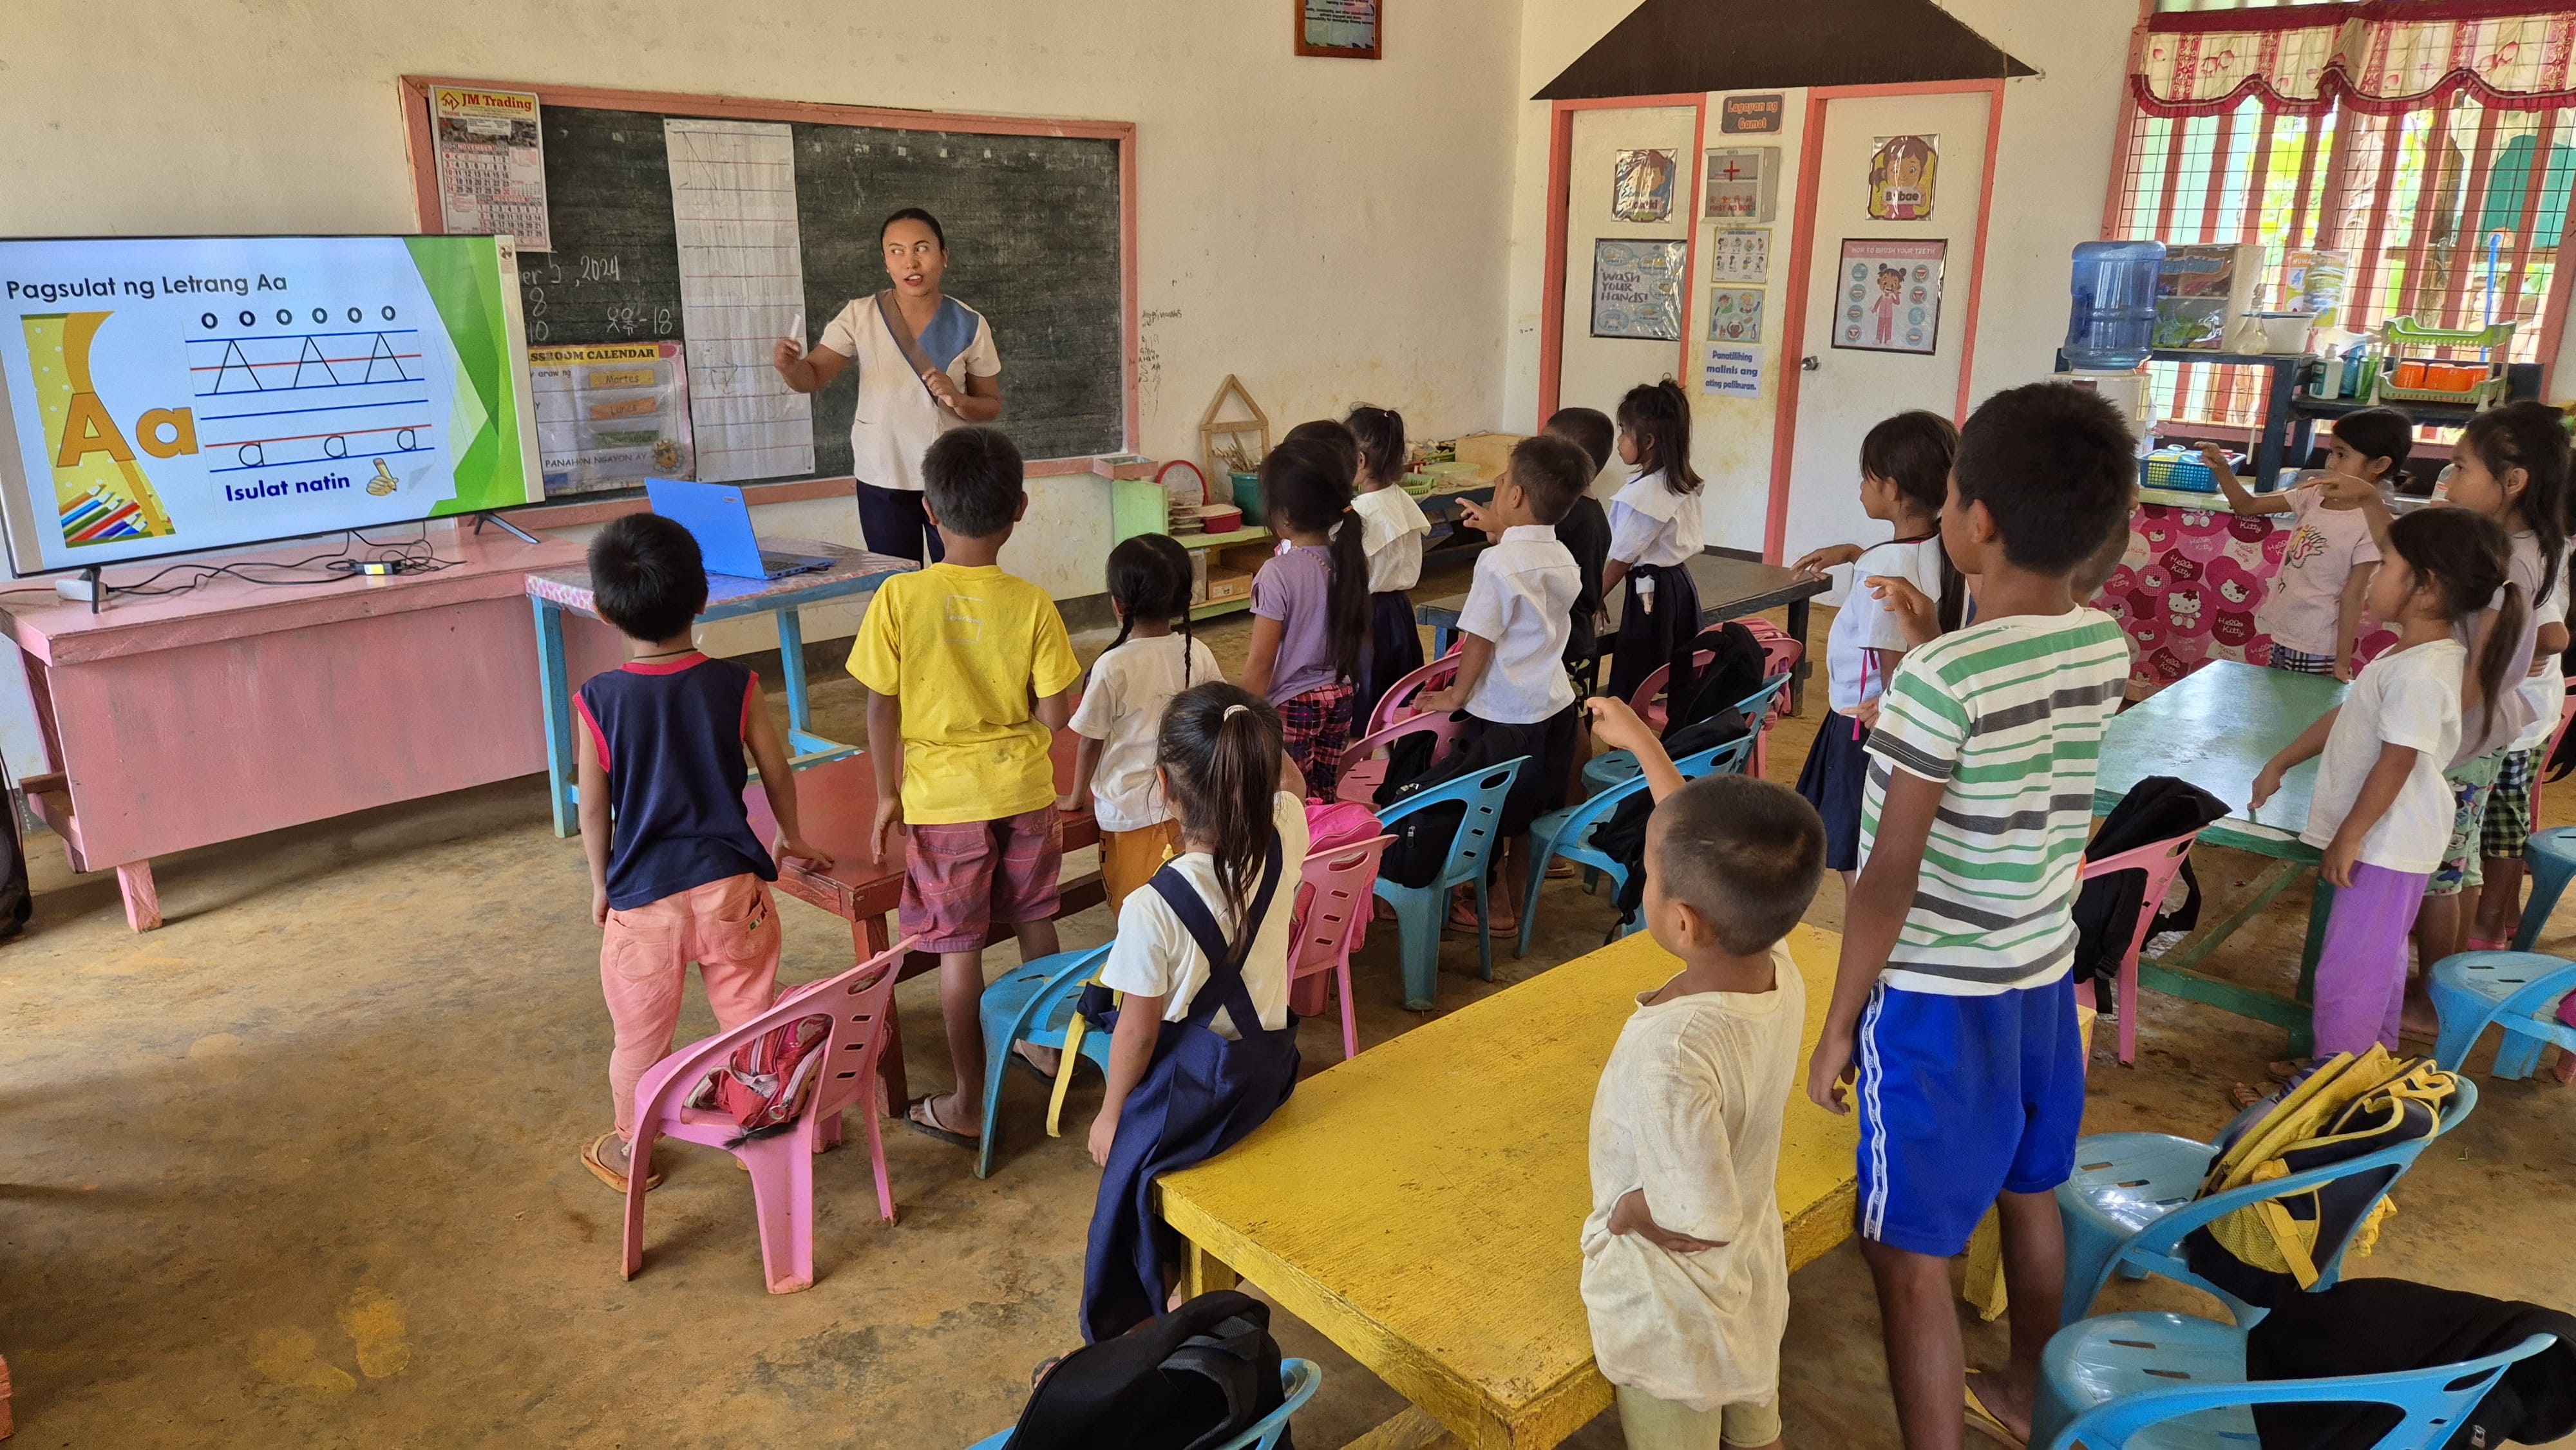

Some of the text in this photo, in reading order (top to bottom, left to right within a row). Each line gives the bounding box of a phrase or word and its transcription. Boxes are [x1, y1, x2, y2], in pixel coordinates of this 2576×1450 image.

[461, 93, 480, 106] JM
[483, 95, 531, 112] Trading
[1728, 101, 1778, 114] Lagayan ng
[1739, 117, 1767, 129] Gamot
[6, 273, 288, 303] Pagsulat ng Letrang Aa
[529, 287, 546, 317] 8
[530, 321, 548, 343] 10
[530, 348, 654, 362] SSROOM CALENDAR
[1712, 350, 1752, 362] Panatilihing
[214, 332, 407, 394] A A A
[562, 370, 571, 378] ng
[605, 372, 639, 384] Martes
[1707, 364, 1757, 377] malinis ang
[1705, 379, 1722, 389] ating
[238, 427, 417, 467] a a a
[545, 458, 591, 468] PANAHON
[594, 455, 632, 464] NGAYON
[225, 472, 350, 502] Isulat natin
[2240, 522, 2262, 533] Kitty
[2170, 554, 2193, 569] Hello
[2170, 563, 2192, 578] Kitty
[2218, 617, 2244, 626] Hello
[2222, 625, 2245, 637] Kitty
[2159, 652, 2180, 668] Hello
[2159, 661, 2179, 677] Kitty
